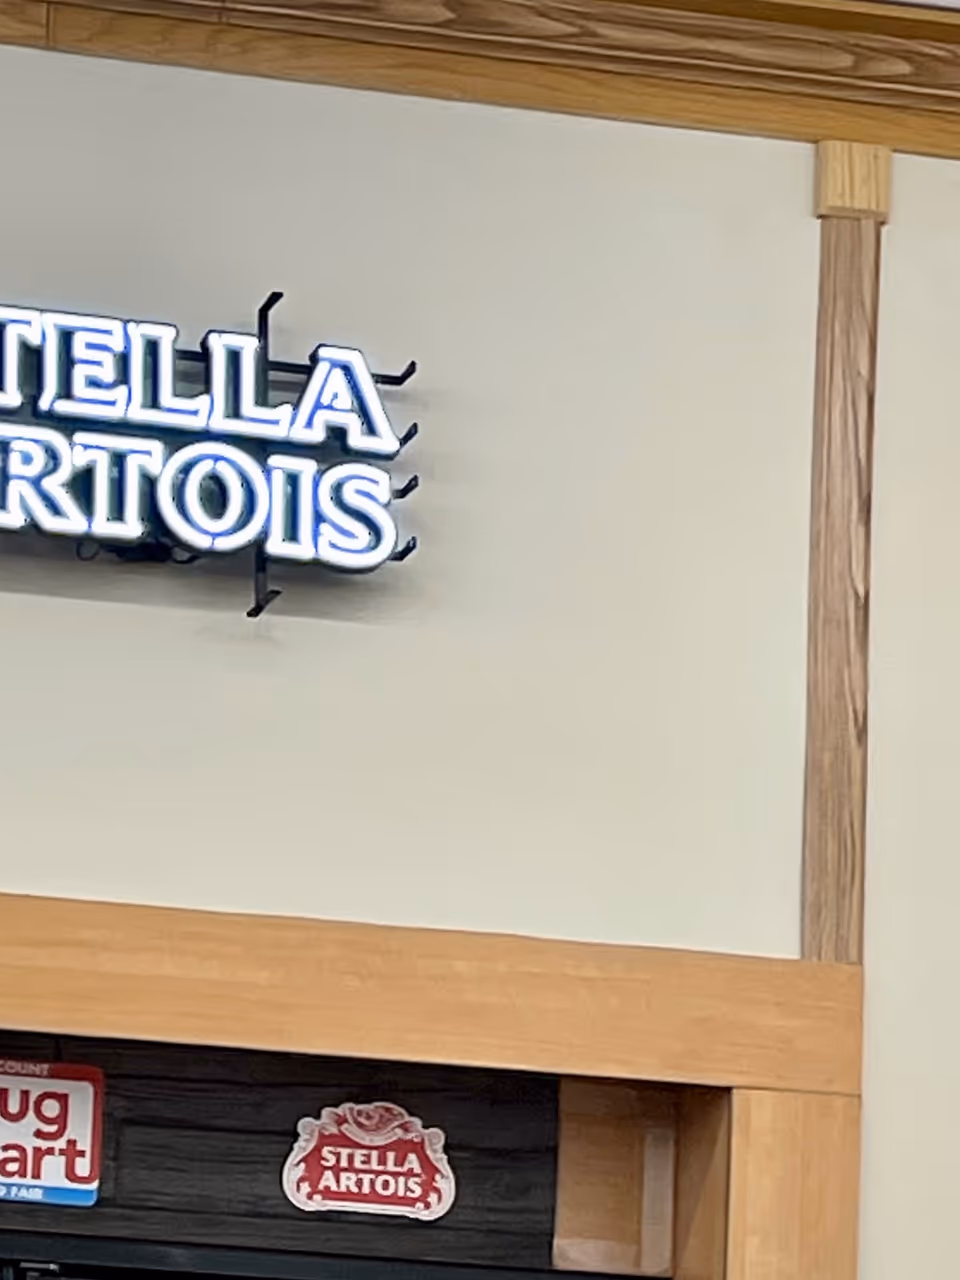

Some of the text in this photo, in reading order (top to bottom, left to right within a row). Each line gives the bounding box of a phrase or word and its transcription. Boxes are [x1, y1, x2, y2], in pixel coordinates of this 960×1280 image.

[321, 1146, 422, 1174] STELLA
[10, 1186, 44, 1199] FAIR
[317, 1171, 424, 1199] ARTOIS
